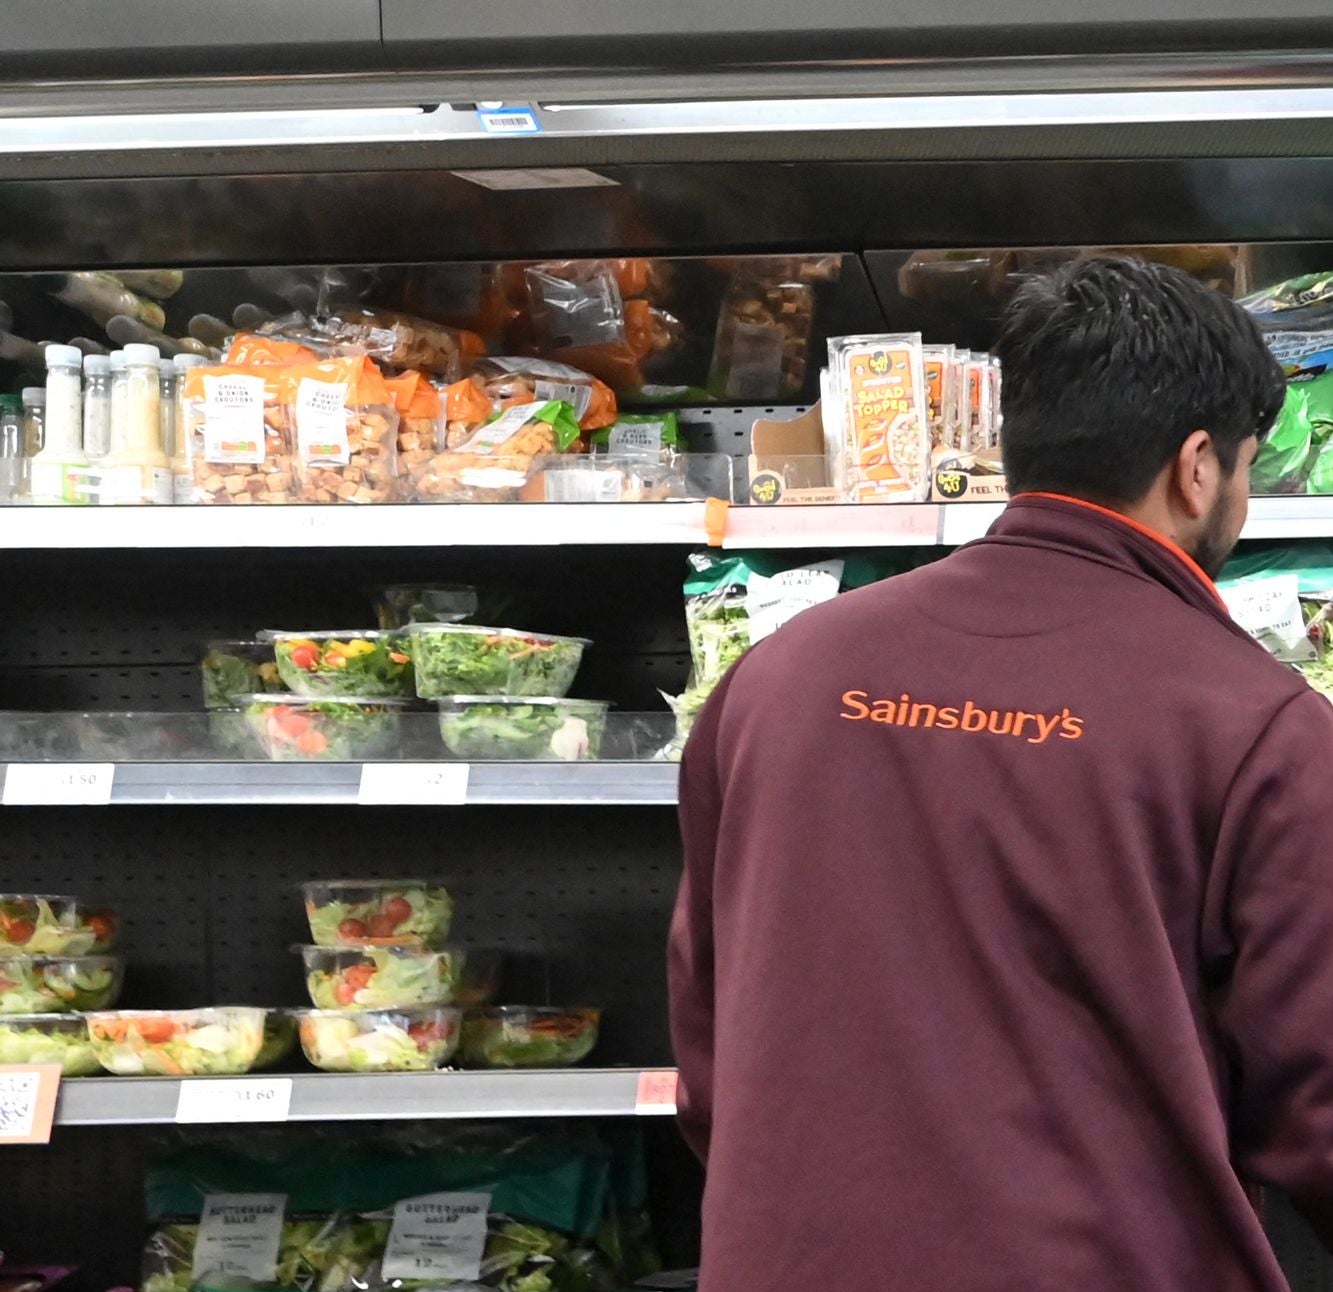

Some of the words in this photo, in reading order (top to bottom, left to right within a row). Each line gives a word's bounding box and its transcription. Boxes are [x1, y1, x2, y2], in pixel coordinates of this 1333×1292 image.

[857, 386, 905, 404] SALAD
[854, 400, 910, 418] TOPPER
[970, 486, 993, 495] FEEL
[996, 485, 1009, 493] TH
[840, 689, 1085, 744] Sainsbury's
